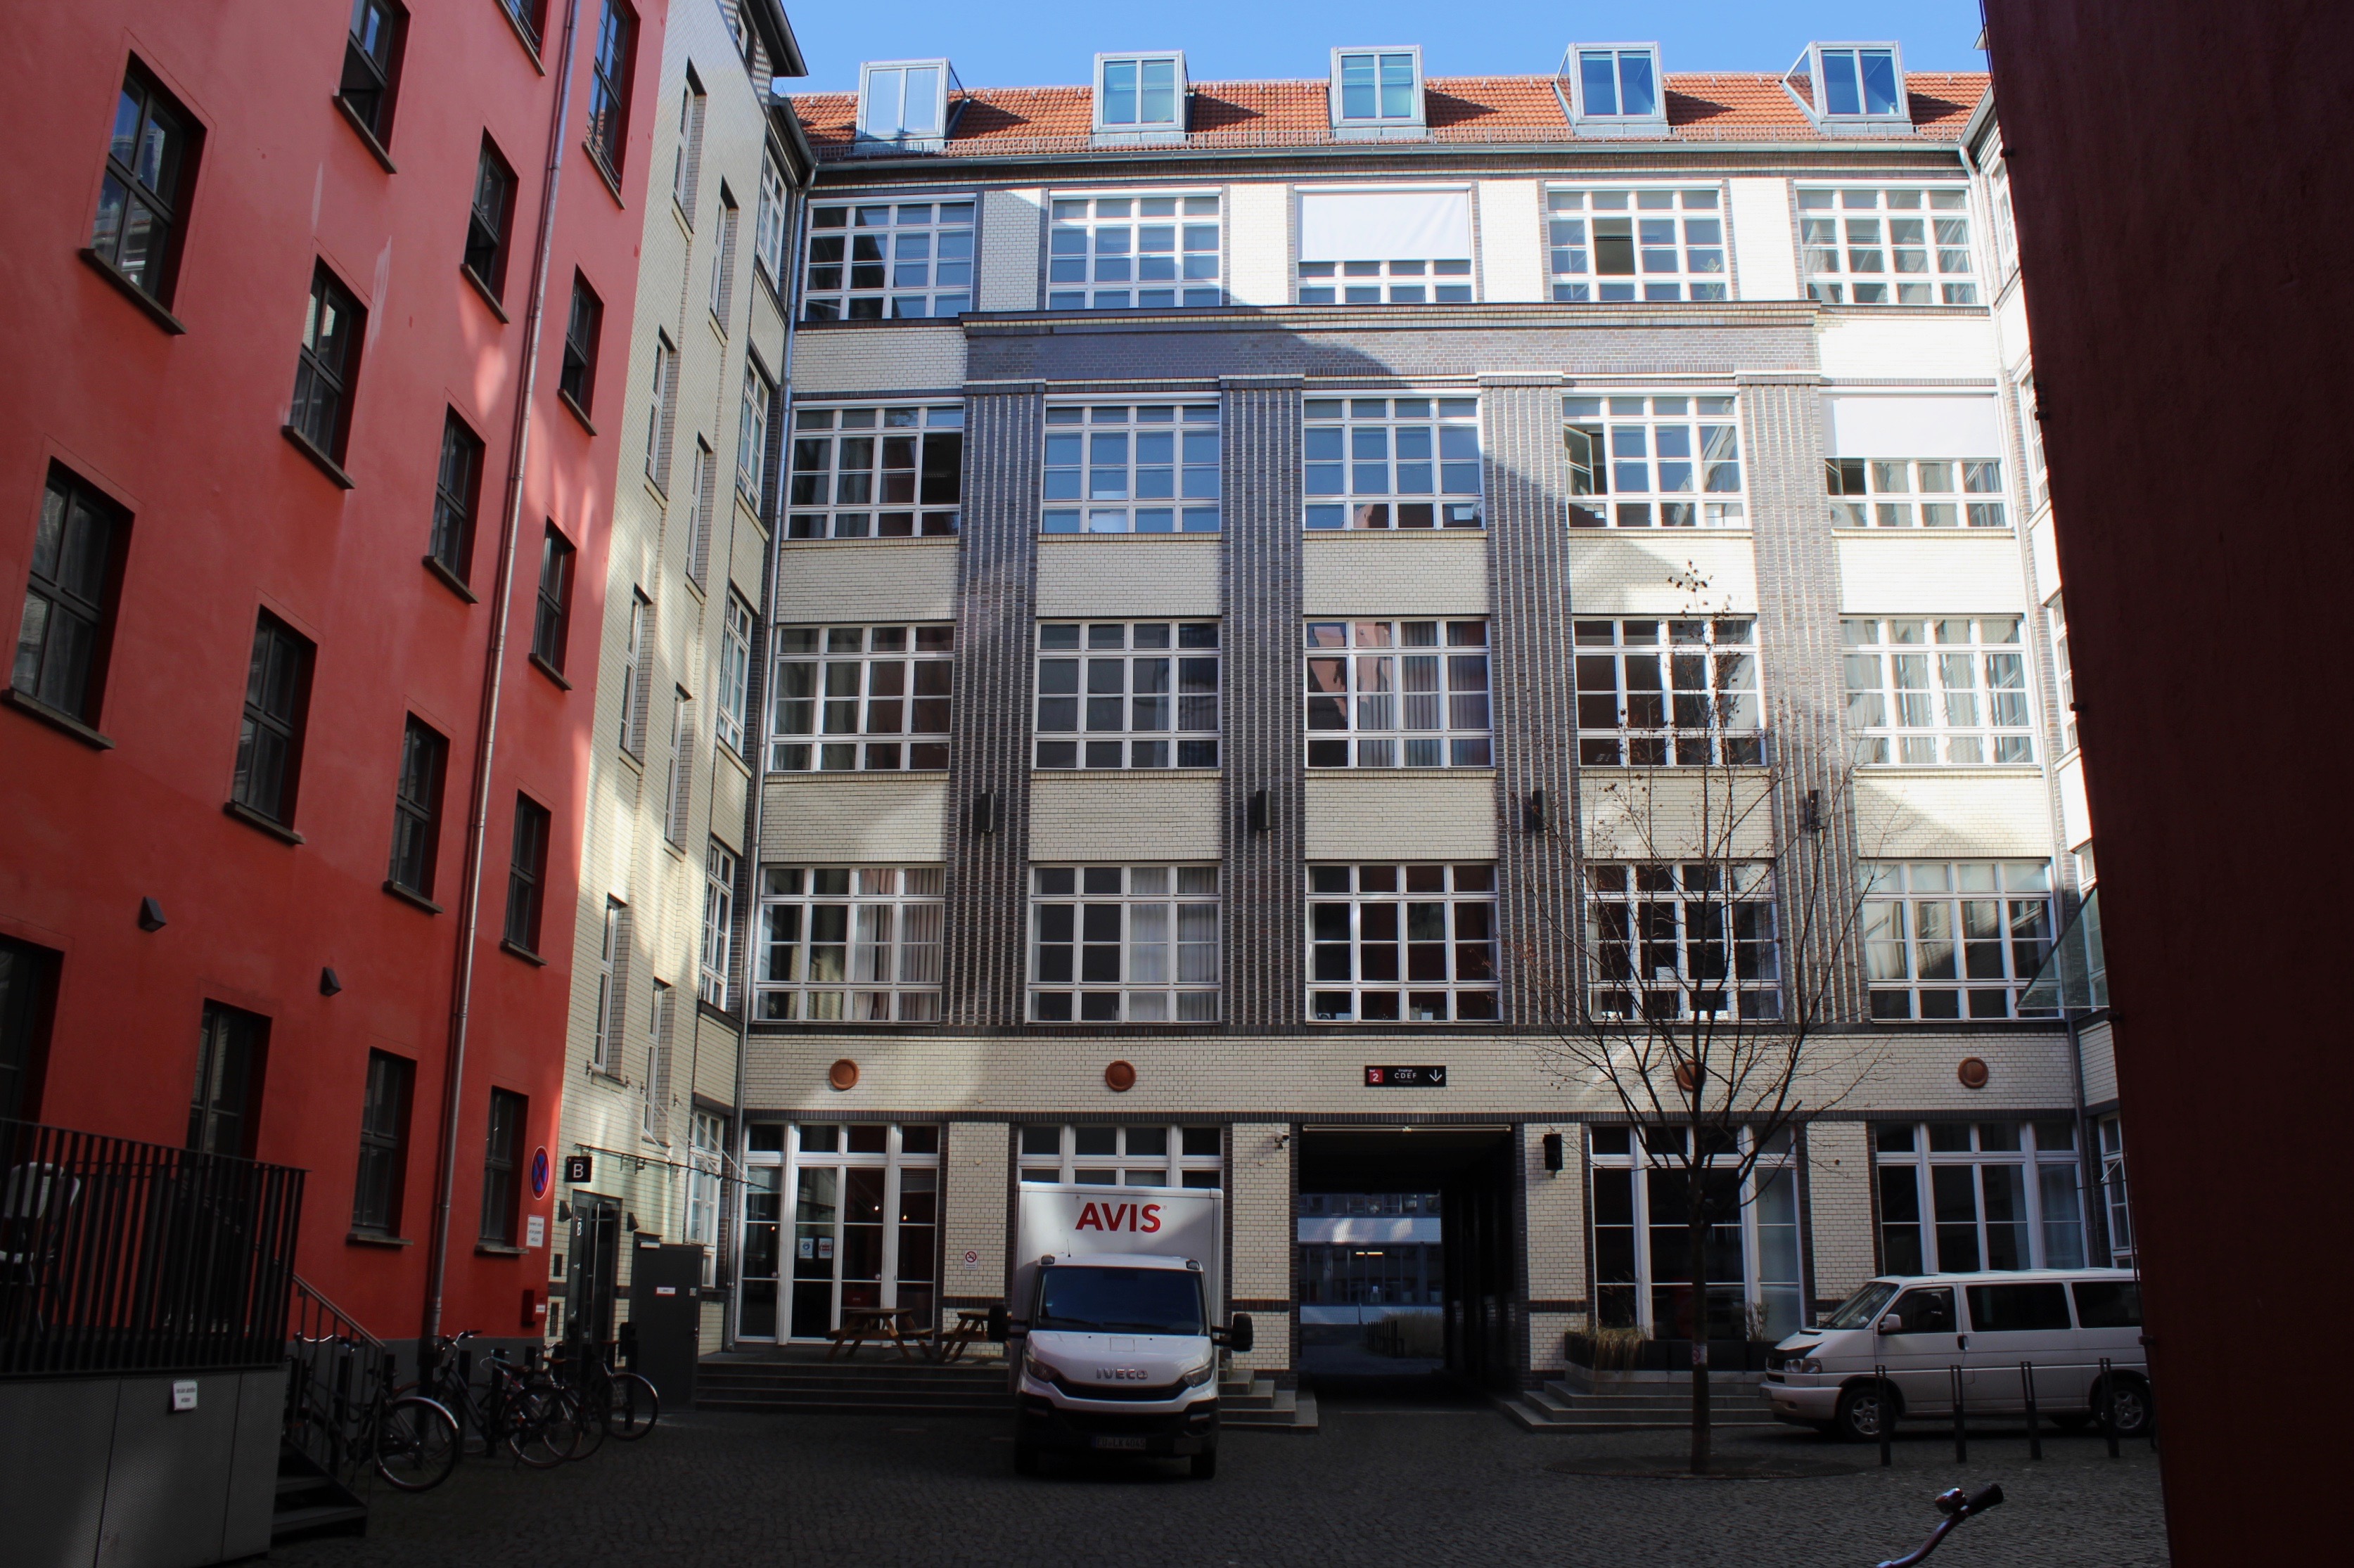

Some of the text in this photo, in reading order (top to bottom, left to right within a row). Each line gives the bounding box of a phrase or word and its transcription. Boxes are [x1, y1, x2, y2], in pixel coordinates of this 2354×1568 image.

[1372, 1073, 1379, 1082] 2
[573, 1163, 584, 1178] B
[1075, 1202, 1161, 1233] AVIS
[577, 1221, 582, 1236] B
[1096, 1368, 1149, 1380] IVECO
